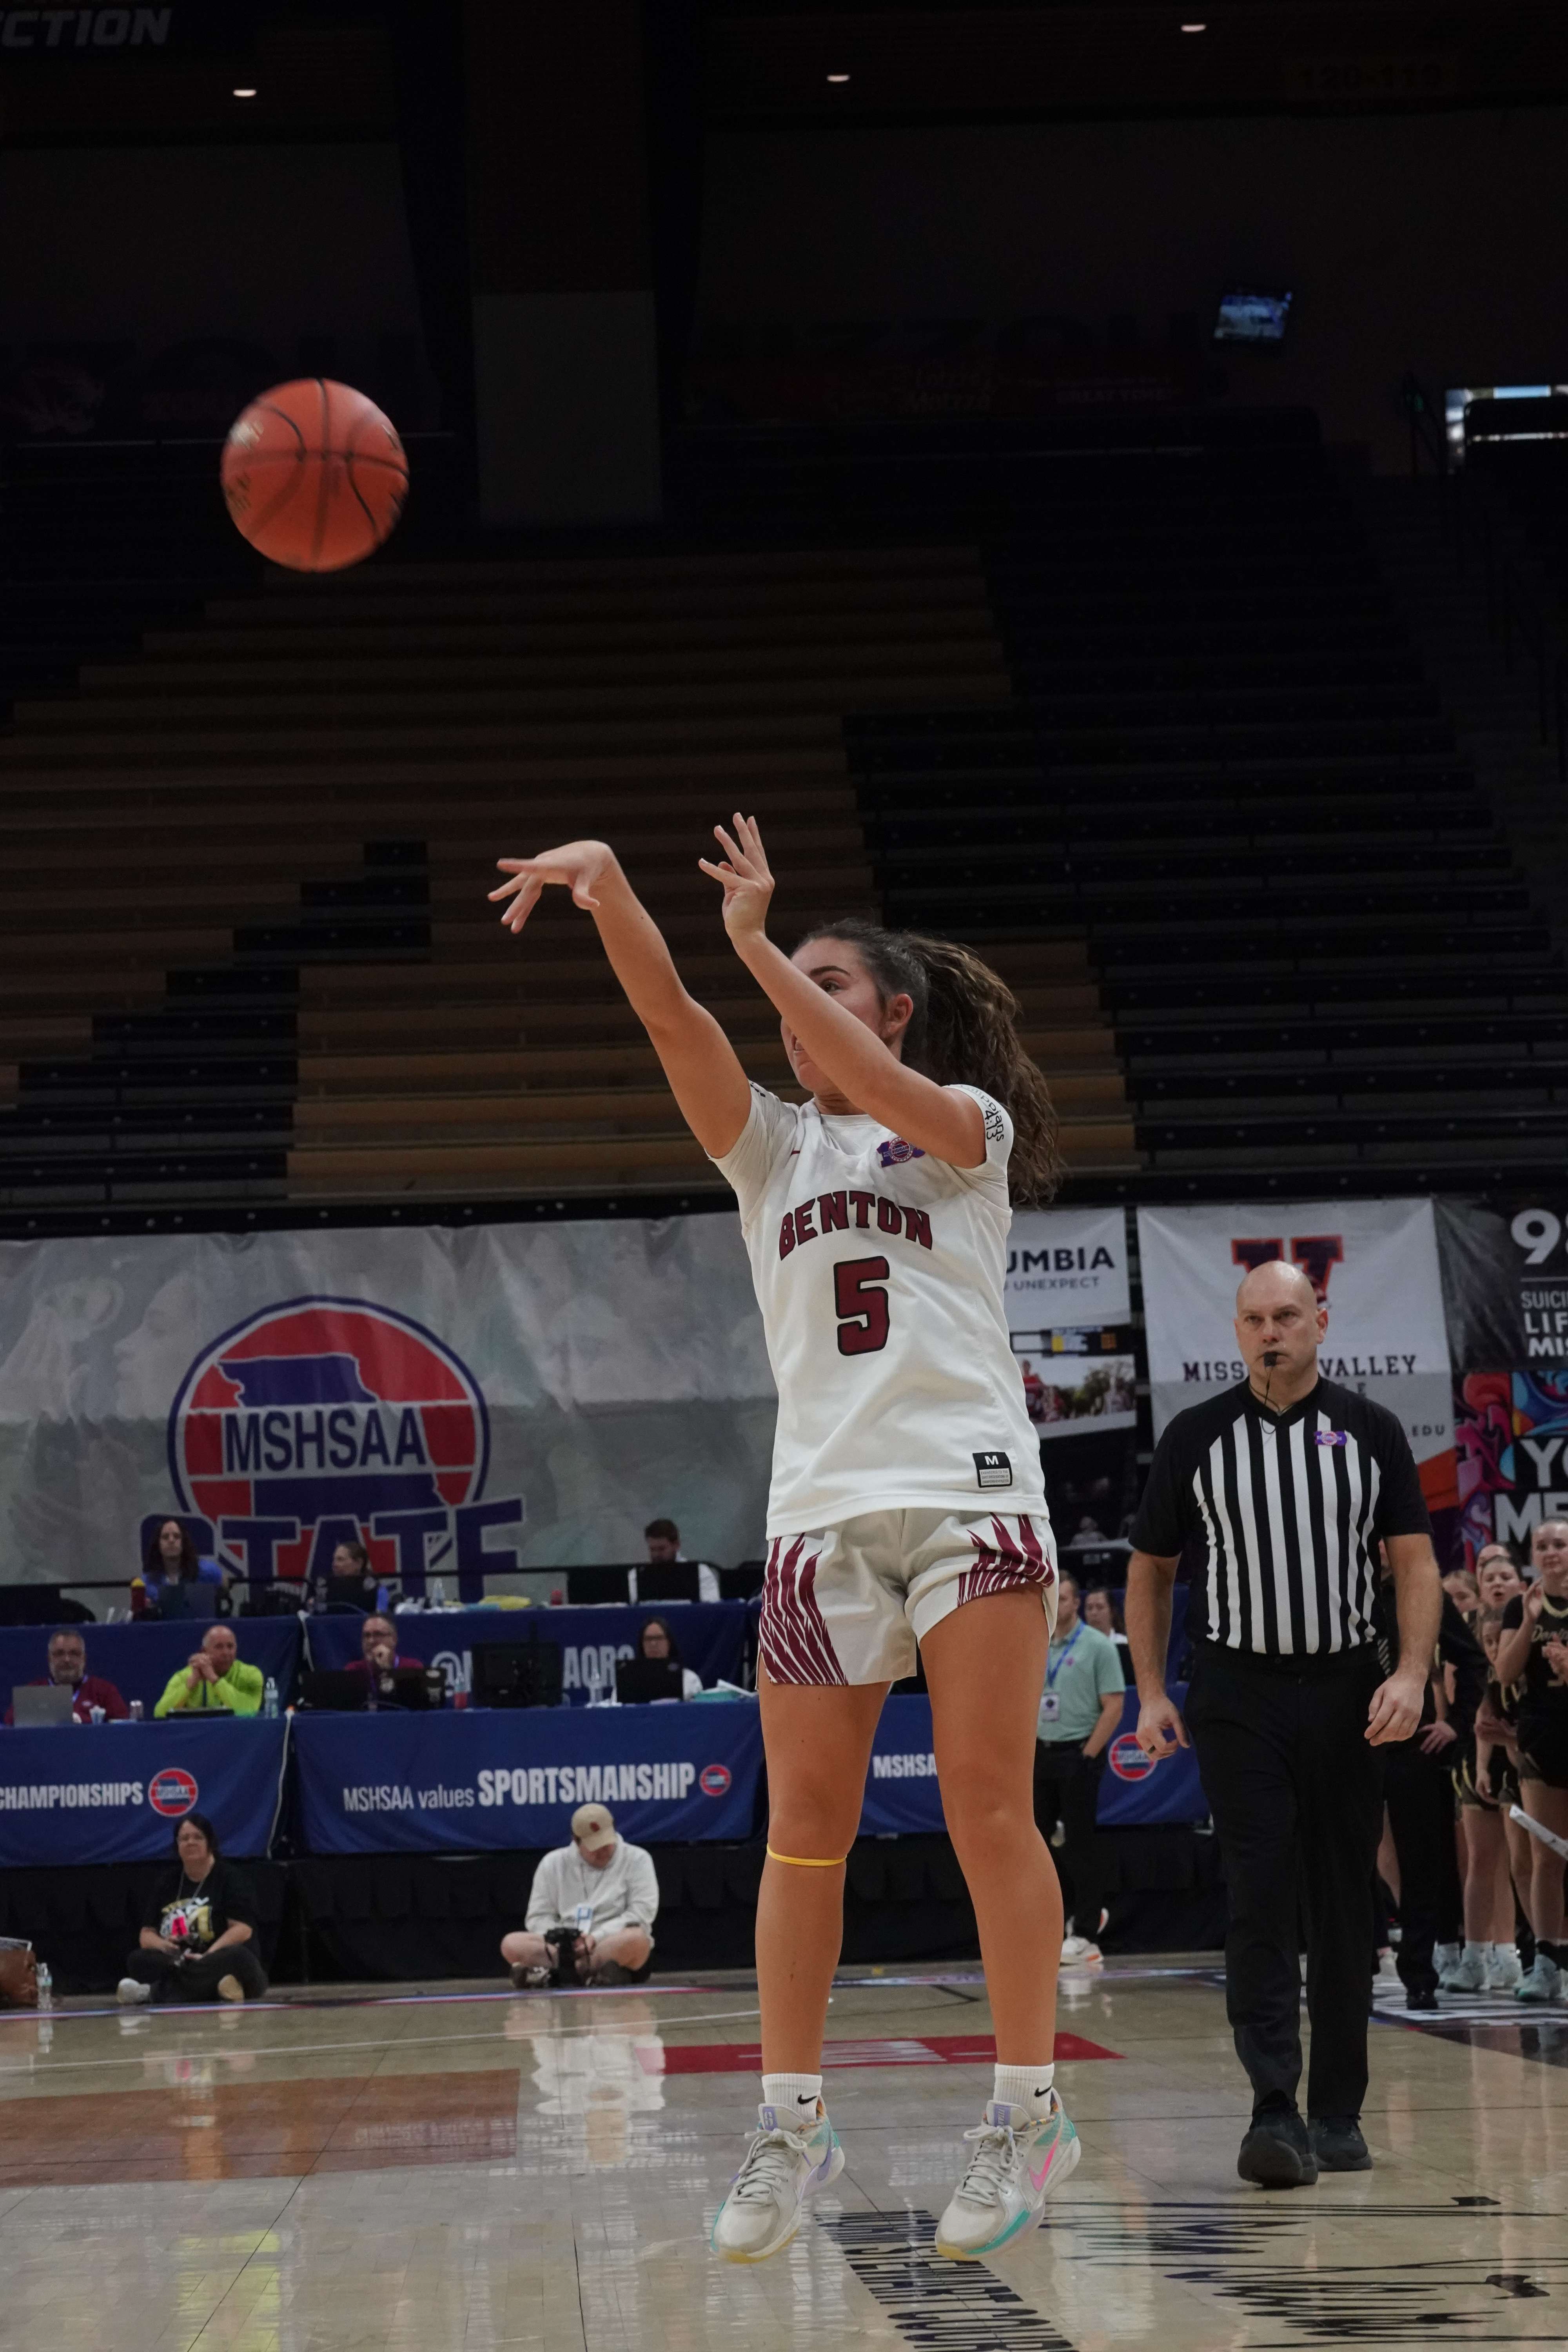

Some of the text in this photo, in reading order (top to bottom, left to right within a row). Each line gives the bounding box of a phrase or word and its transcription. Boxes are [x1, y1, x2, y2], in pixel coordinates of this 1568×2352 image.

[0, 7, 172, 47] CTION
[985, 1110, 998, 1140] 4:13
[779, 1190, 933, 1261] BENTON
[1510, 1209, 1568, 1265] 9
[1013, 1276, 1099, 1290] UNEXPECT
[833, 1256, 890, 1356] 5
[1318, 1355, 1416, 1377] VALLEY
[226, 1408, 426, 1472] MSHSAA
[984, 1455, 999, 1465] M
[343, 1785, 415, 1812] MSHSAA
[417, 1783, 475, 1809] values
[477, 1762, 695, 1807] SPORTSMANSHIP
[887, 2308, 1080, 2352] COUR
